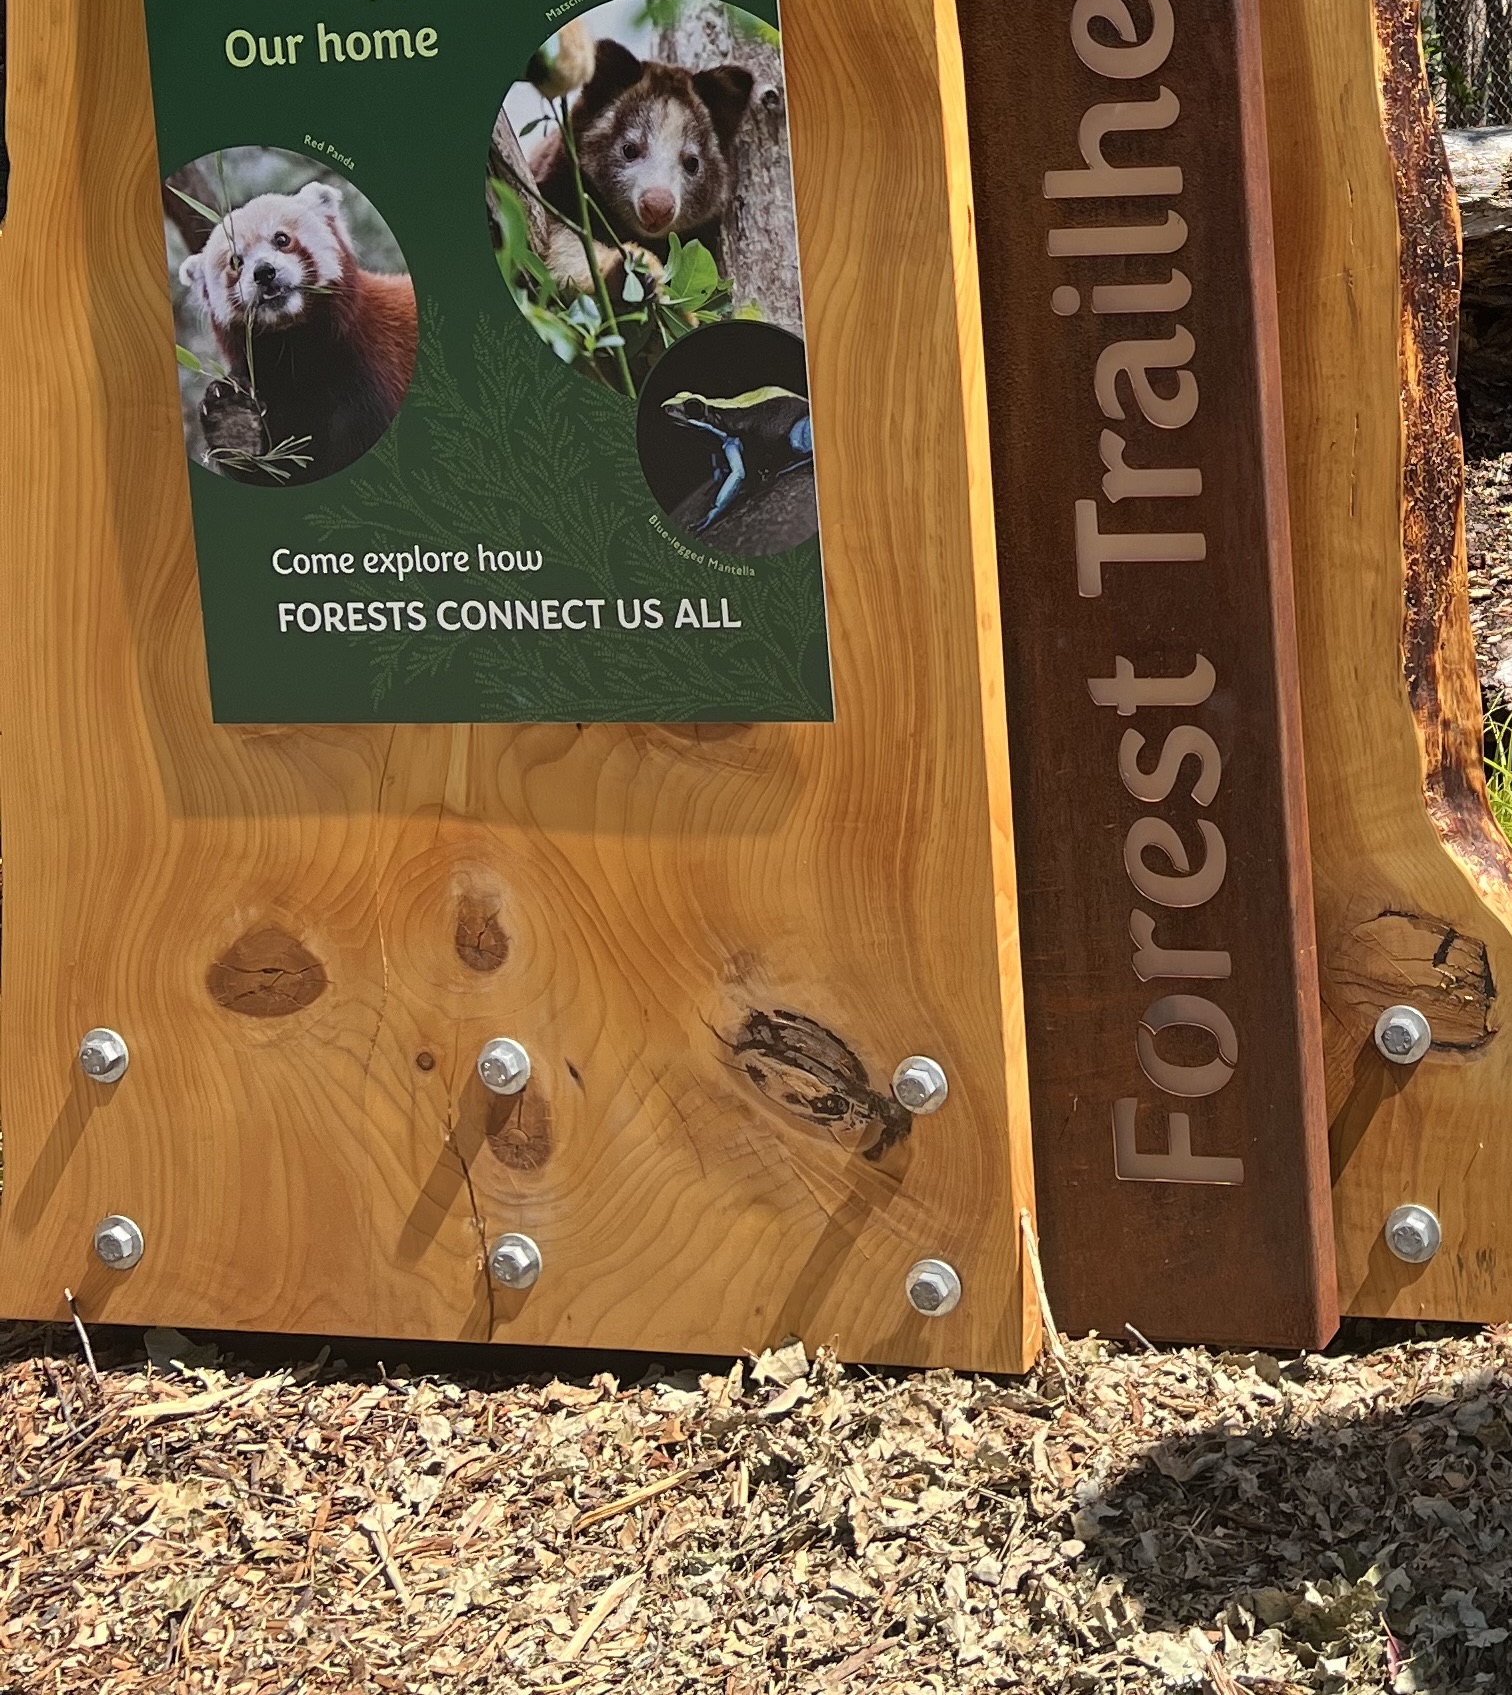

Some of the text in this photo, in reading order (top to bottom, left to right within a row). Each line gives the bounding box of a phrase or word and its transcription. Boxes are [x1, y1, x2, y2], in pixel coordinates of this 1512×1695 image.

[225, 22, 439, 68] Our home
[303, 134, 356, 171] Red Panda
[272, 543, 543, 582] Come explore how
[648, 514, 756, 577] Blue-legged Mantella
[278, 597, 742, 633] FORESTS CONNECT US ALL
[1086, 653, 1245, 1186] Forest
